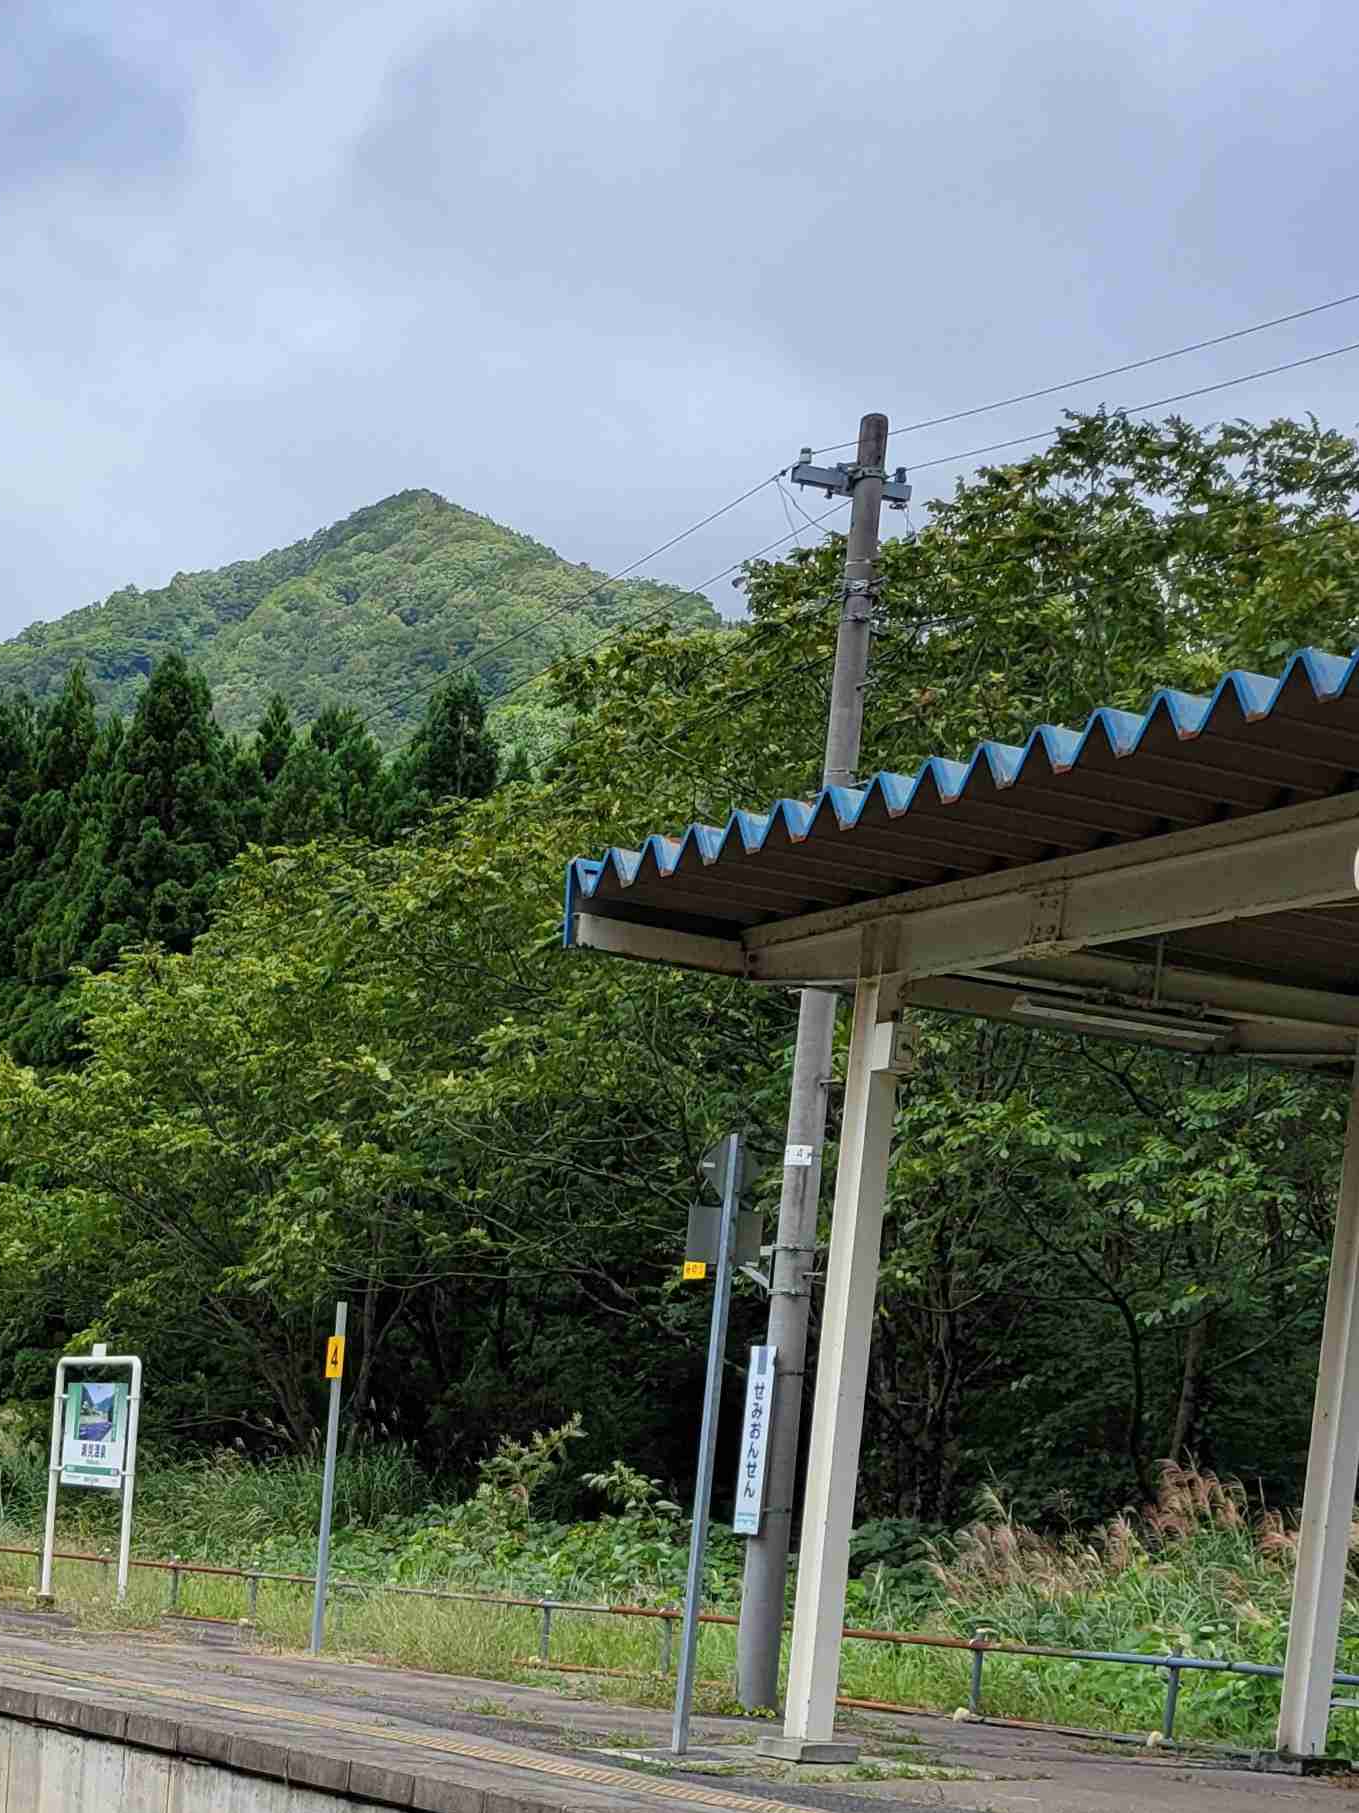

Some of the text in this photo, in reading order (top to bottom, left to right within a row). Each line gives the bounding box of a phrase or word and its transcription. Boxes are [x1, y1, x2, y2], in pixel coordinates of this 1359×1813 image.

[331, 1344, 339, 1368] 4
[743, 1382, 765, 1499] せみおんせん
